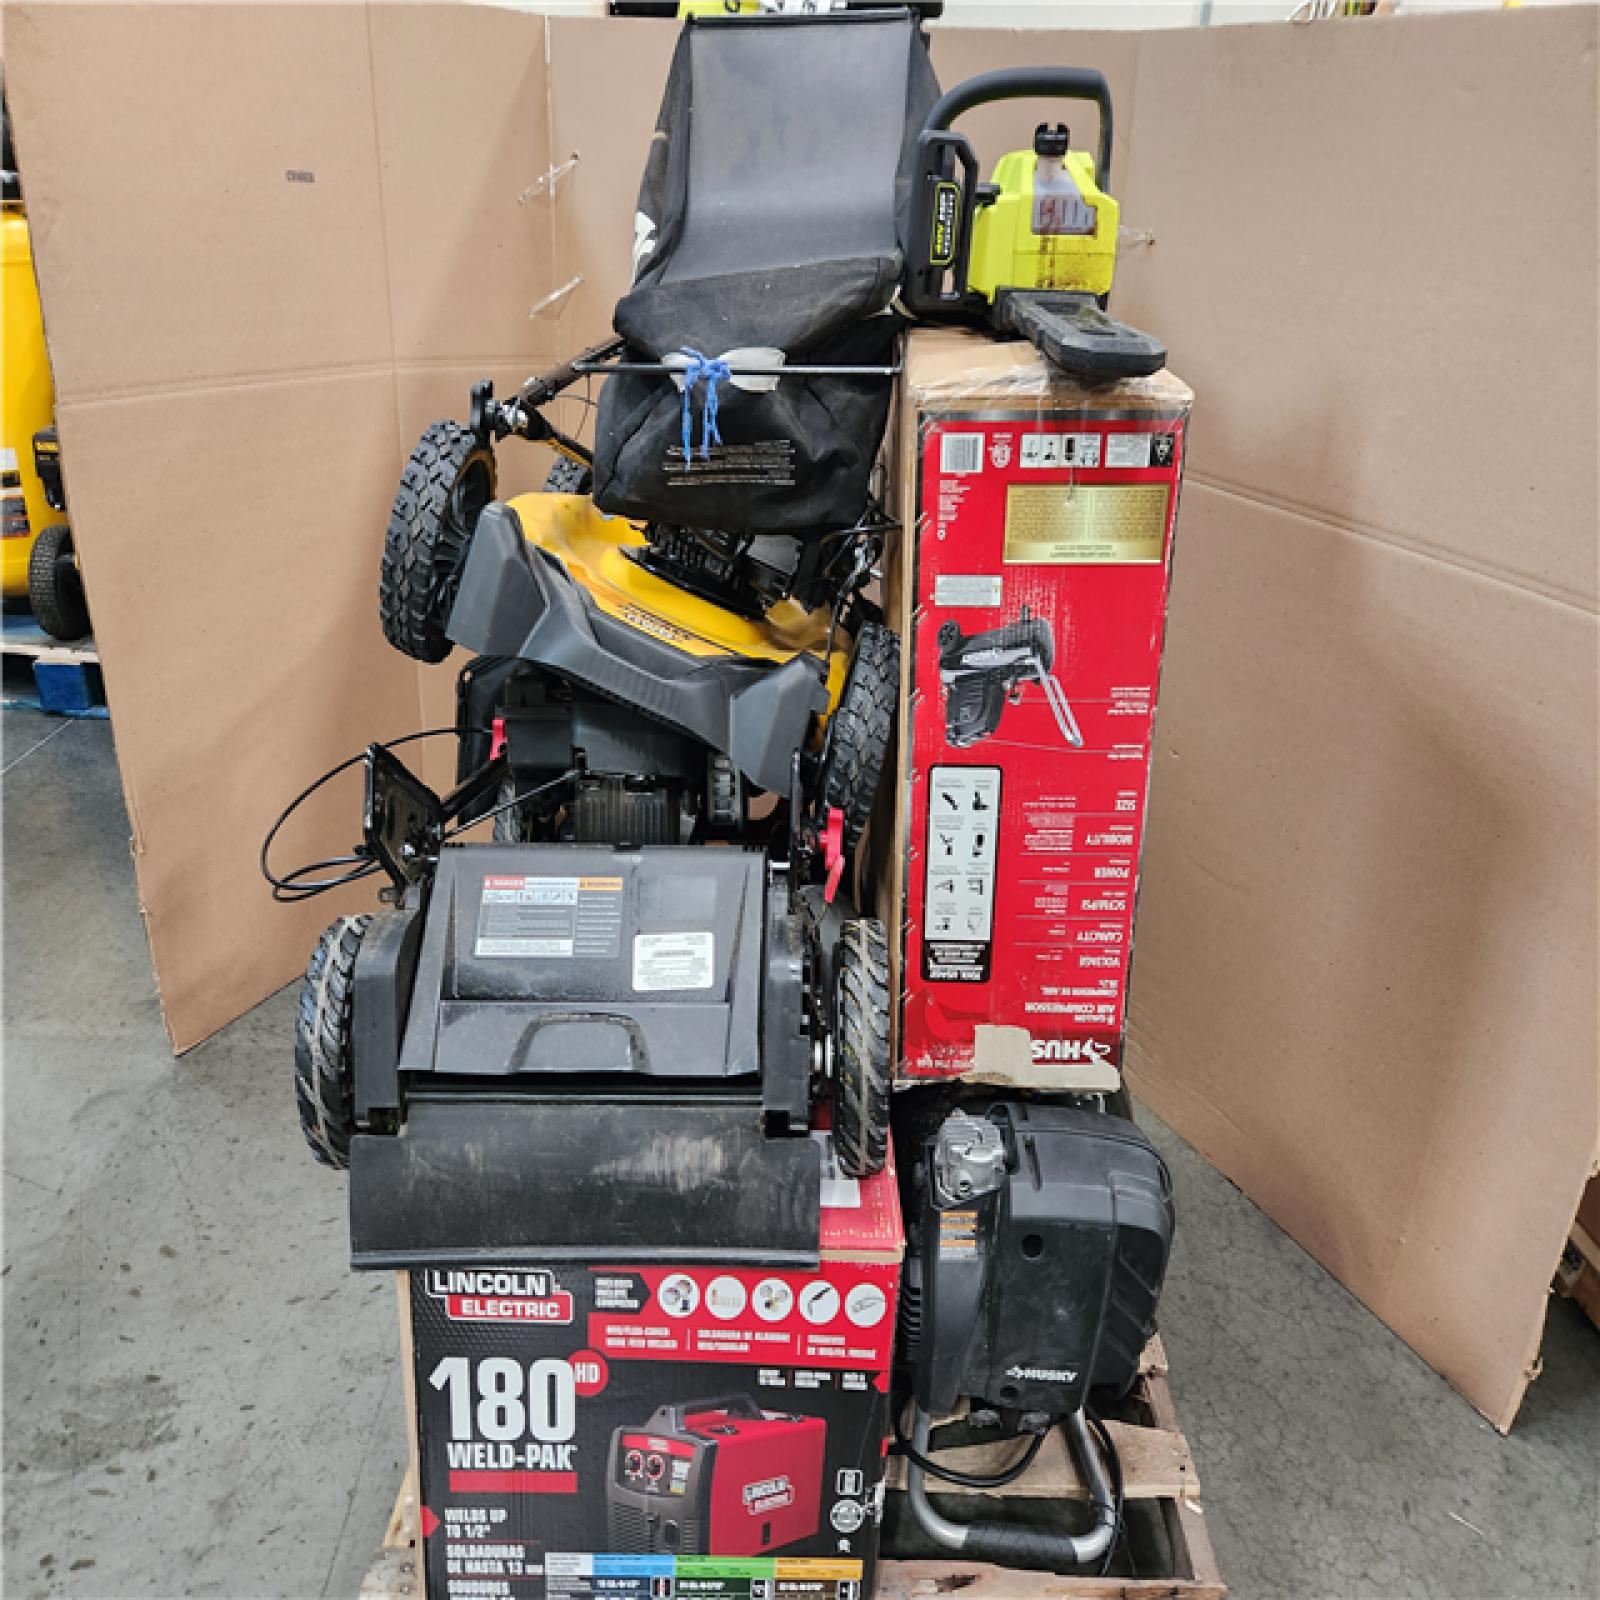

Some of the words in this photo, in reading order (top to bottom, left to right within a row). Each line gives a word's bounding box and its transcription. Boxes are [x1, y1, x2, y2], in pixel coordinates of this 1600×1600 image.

[434, 1269, 546, 1295] LINCOLN
[461, 1299, 560, 1317] ELECTRIC
[429, 1357, 576, 1440] 180
[575, 1362, 599, 1383] HD
[447, 1442, 574, 1470] WELD-PAK
